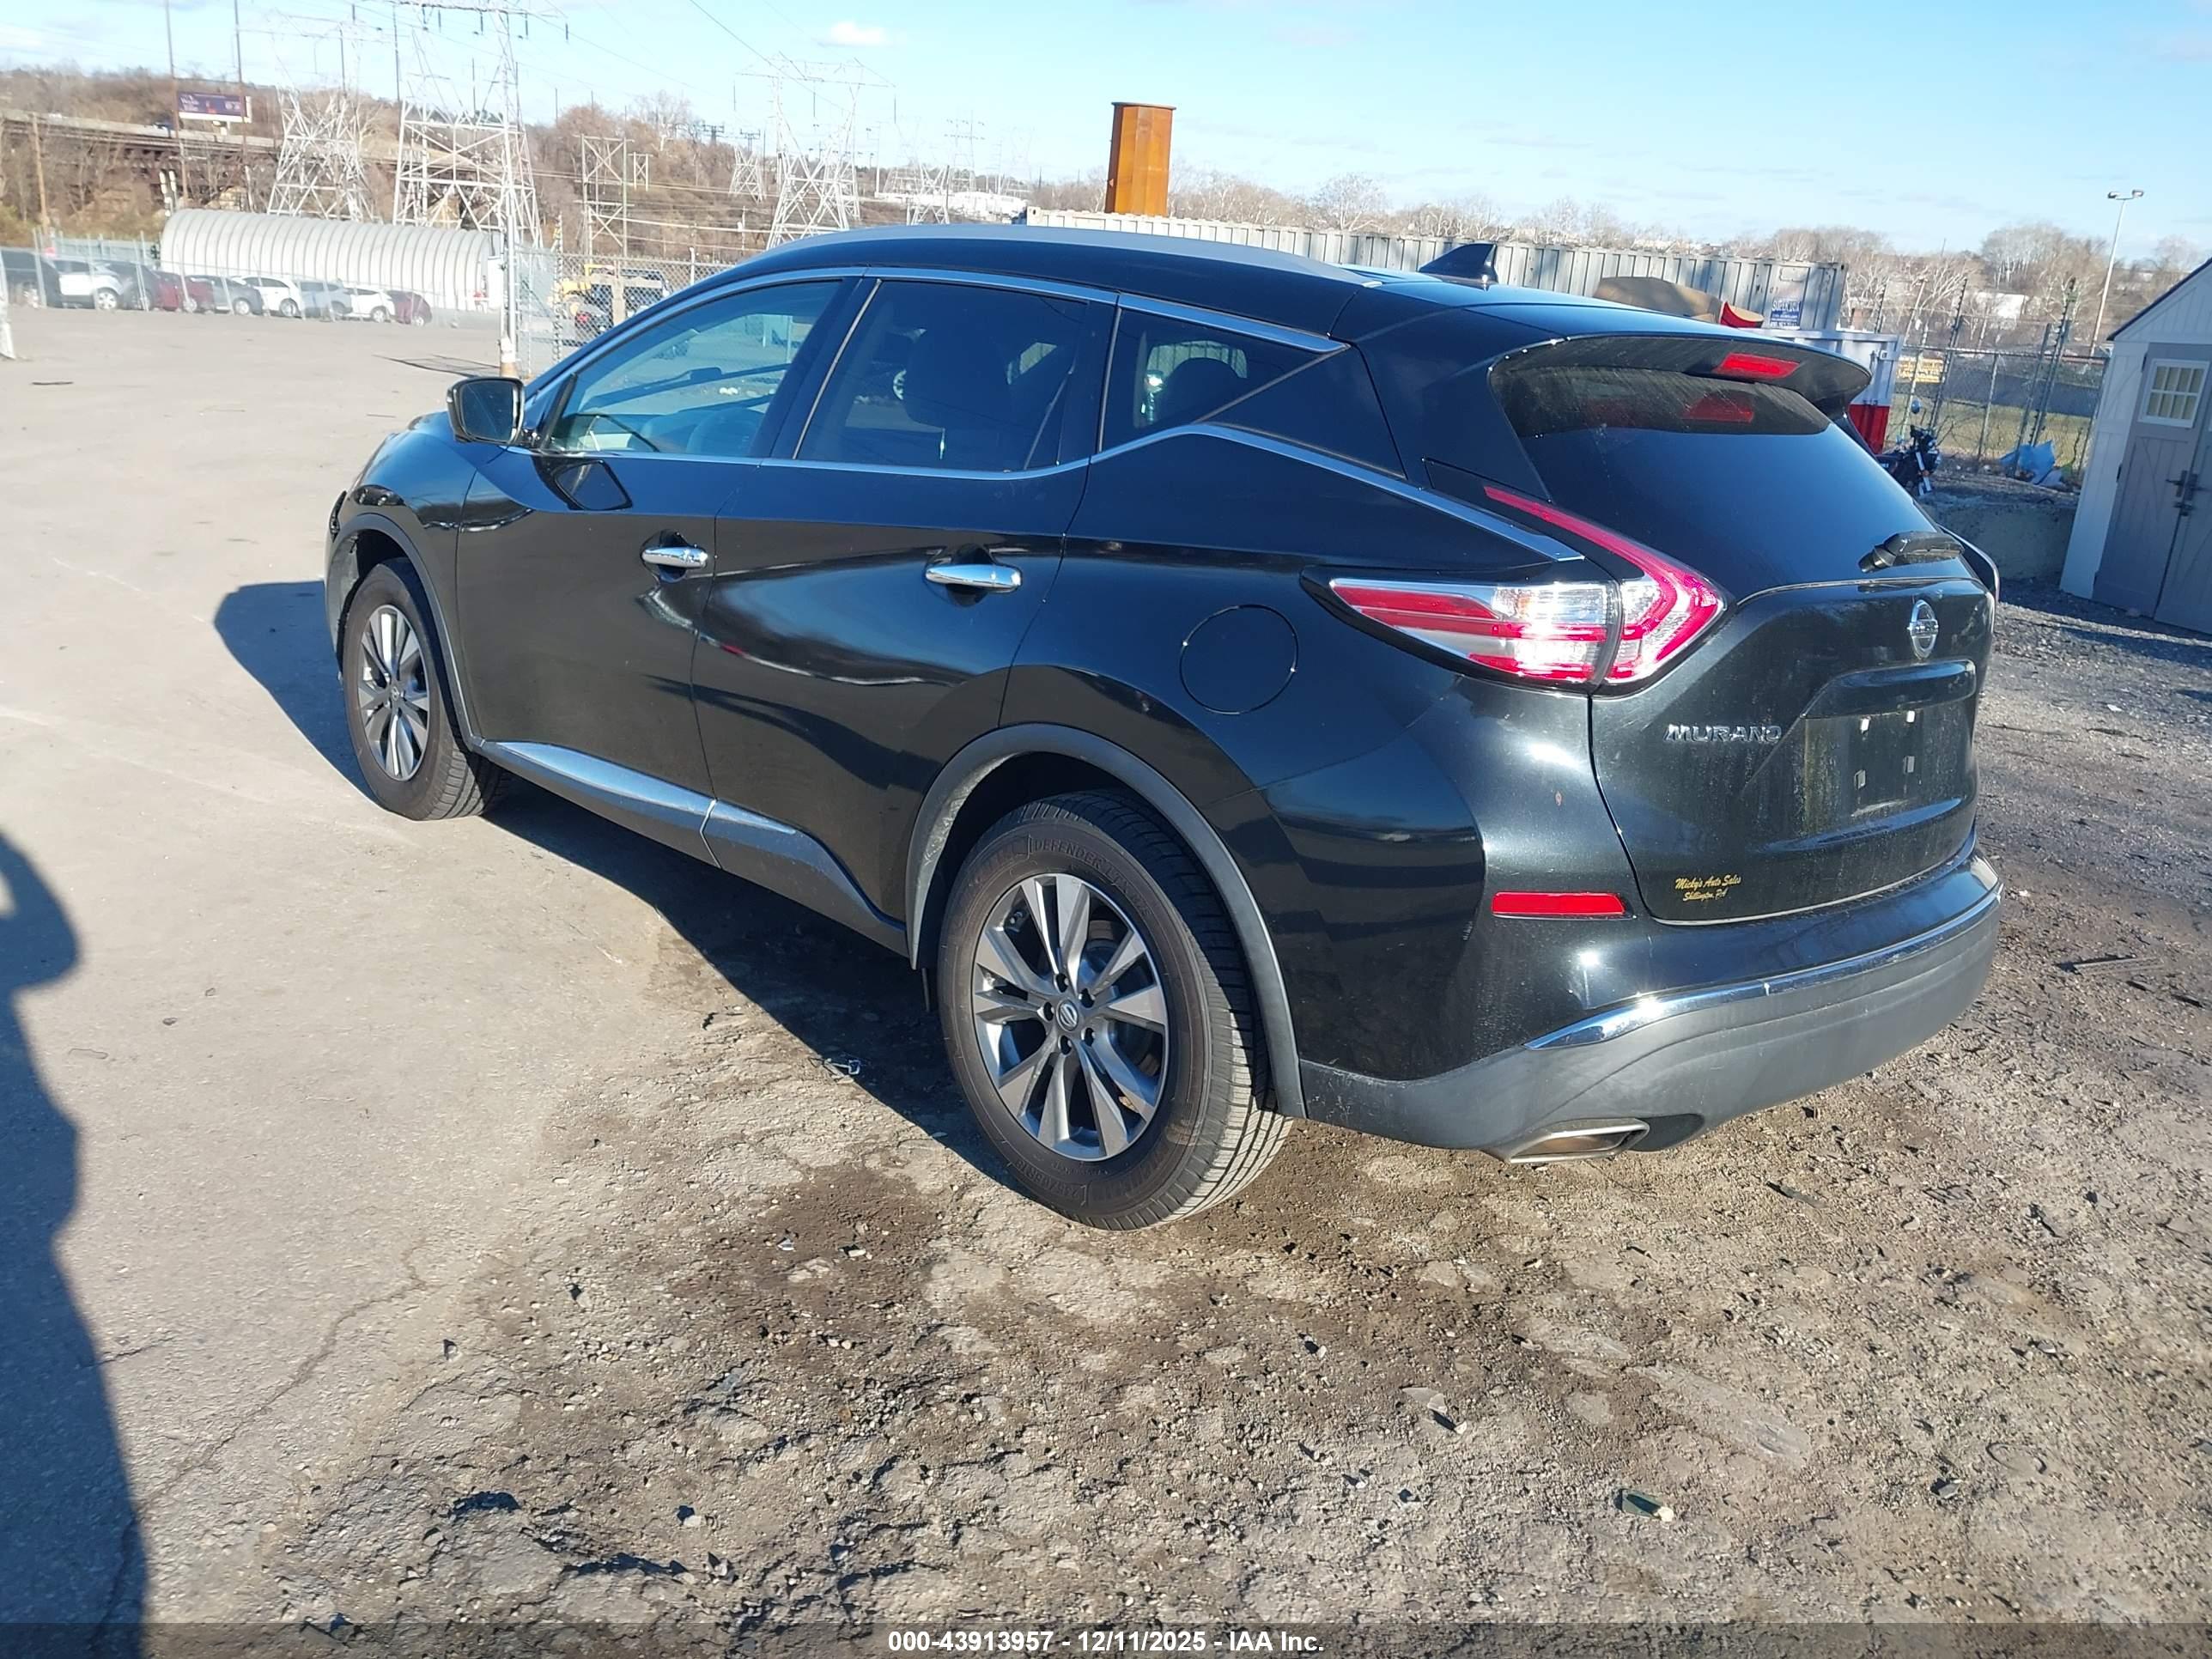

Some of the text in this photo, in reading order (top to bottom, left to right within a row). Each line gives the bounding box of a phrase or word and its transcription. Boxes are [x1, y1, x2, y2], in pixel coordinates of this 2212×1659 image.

[1663, 724, 1782, 743] MURANO
[1034, 838, 1103, 870] DEFENDER
[1703, 875, 1722, 888] Auto
[1722, 874, 1741, 886] Sales
